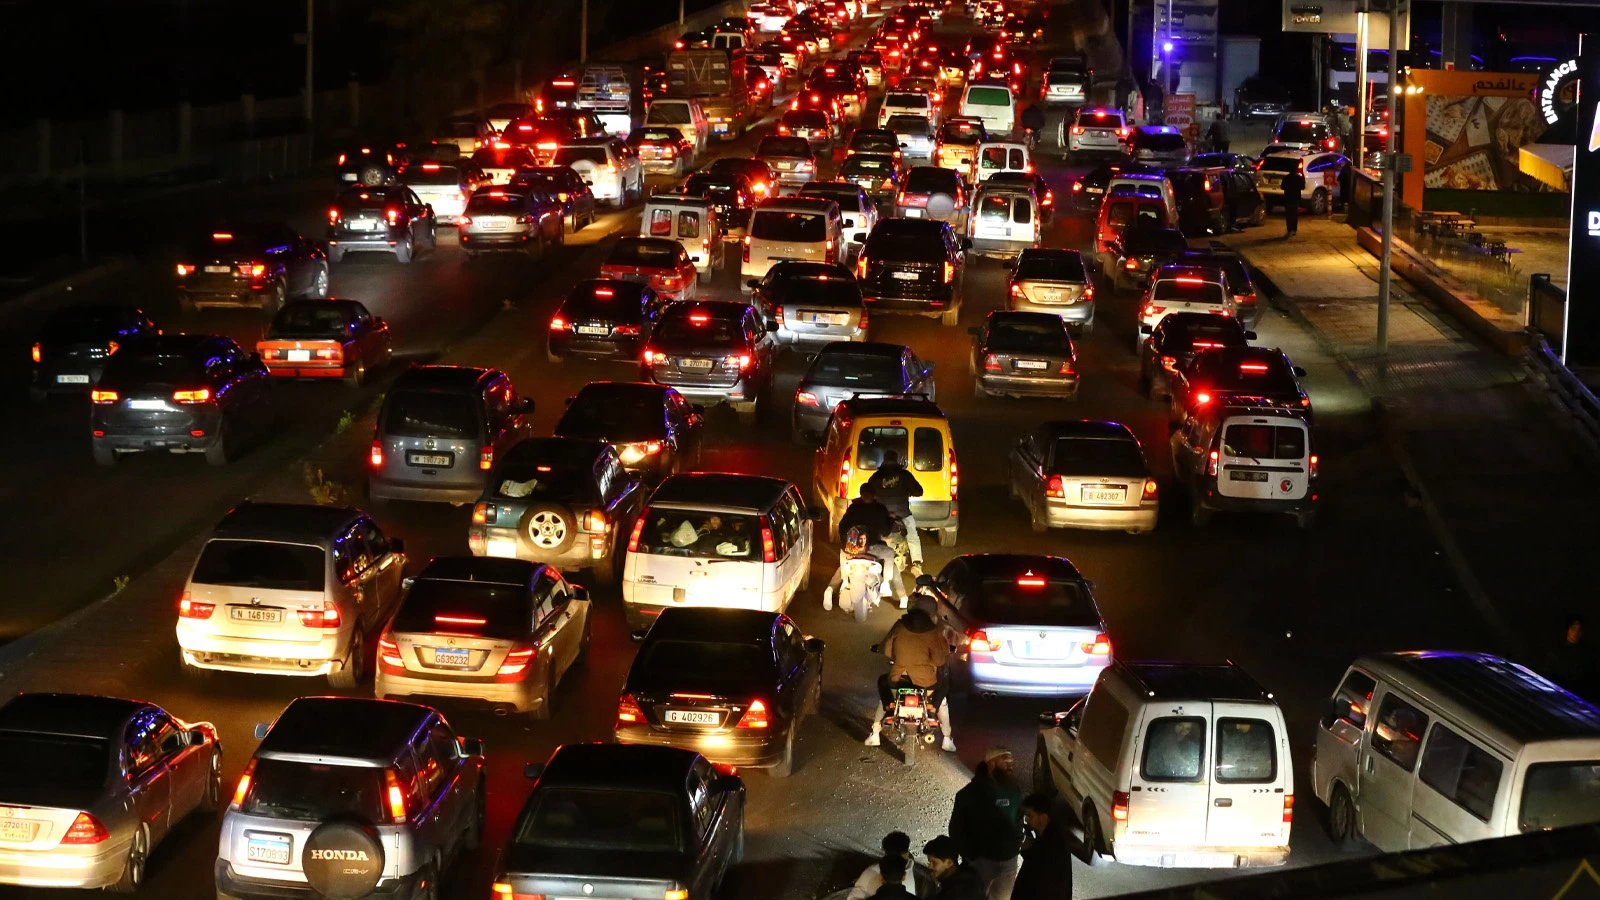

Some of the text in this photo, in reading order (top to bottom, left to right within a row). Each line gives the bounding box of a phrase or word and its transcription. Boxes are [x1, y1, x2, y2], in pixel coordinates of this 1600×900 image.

[1541, 59, 1577, 125] ENTRANCE
[237, 610, 276, 621] N 146199
[435, 655, 468, 665] G639232
[671, 712, 713, 722] G 402926
[311, 849, 369, 861] HONDA
